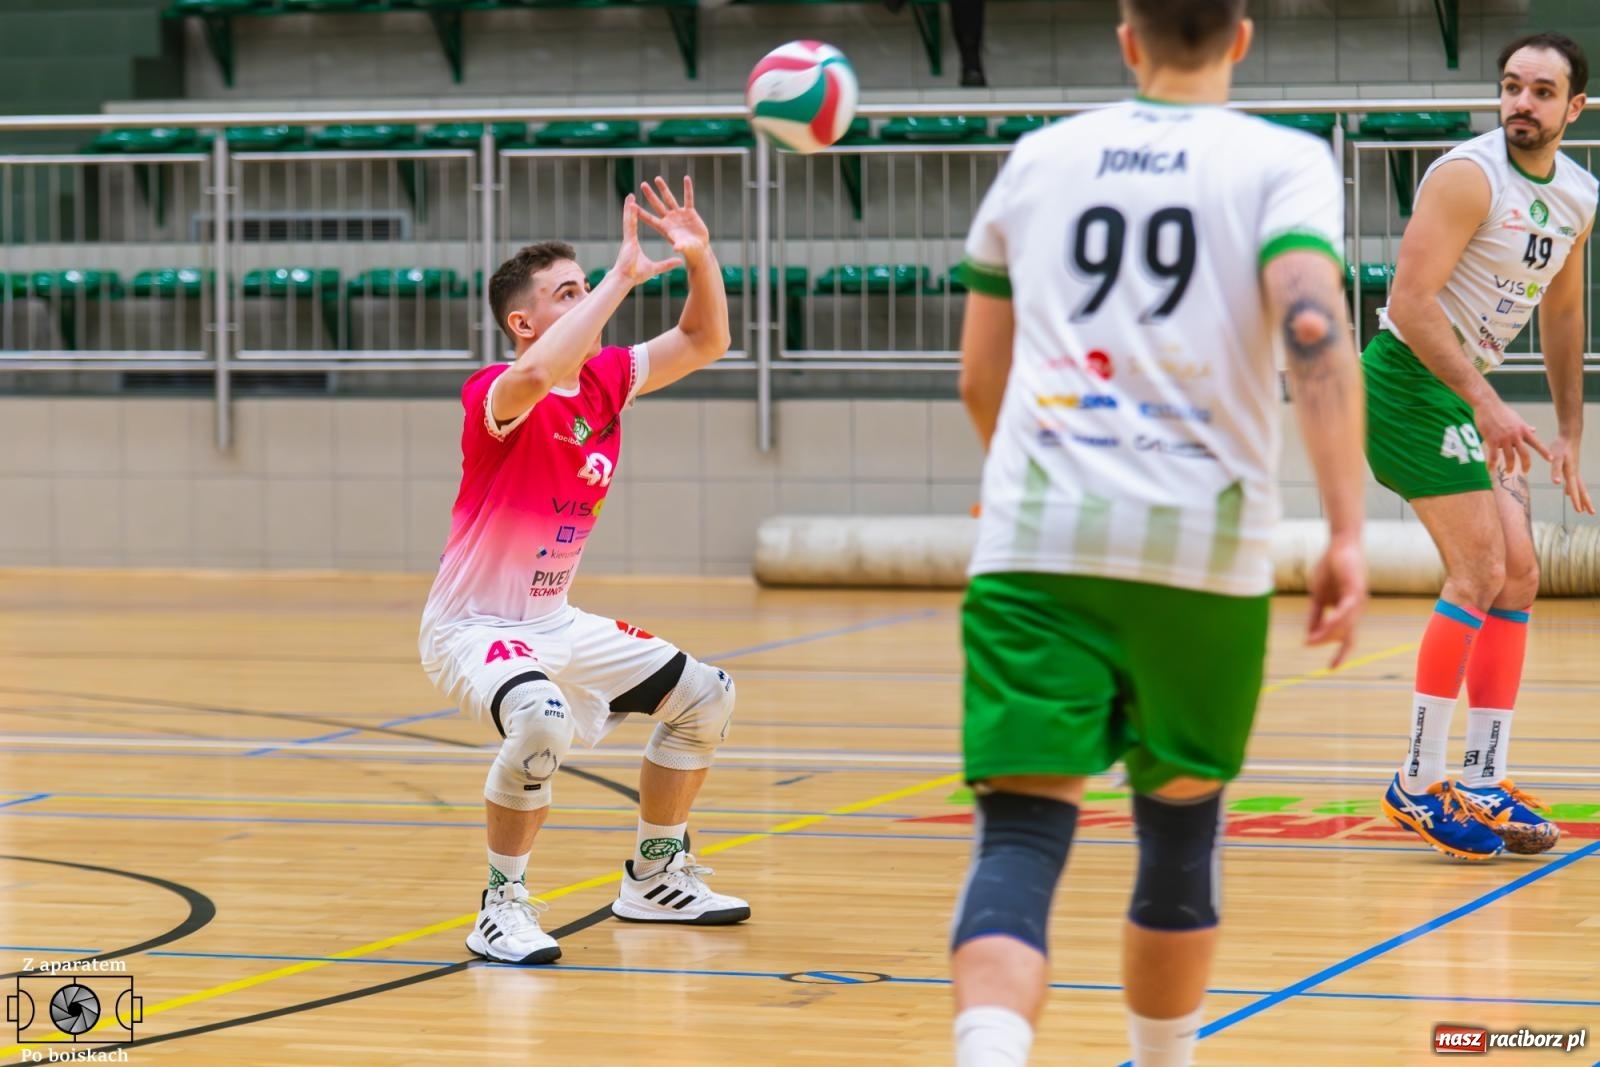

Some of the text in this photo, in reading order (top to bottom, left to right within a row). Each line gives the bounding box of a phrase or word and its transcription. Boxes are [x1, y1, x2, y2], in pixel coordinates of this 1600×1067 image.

[1097, 145, 1188, 178] JOŃCA
[1069, 205, 1197, 323] 99
[1522, 233, 1553, 270] 49
[1440, 423, 1485, 465] 49
